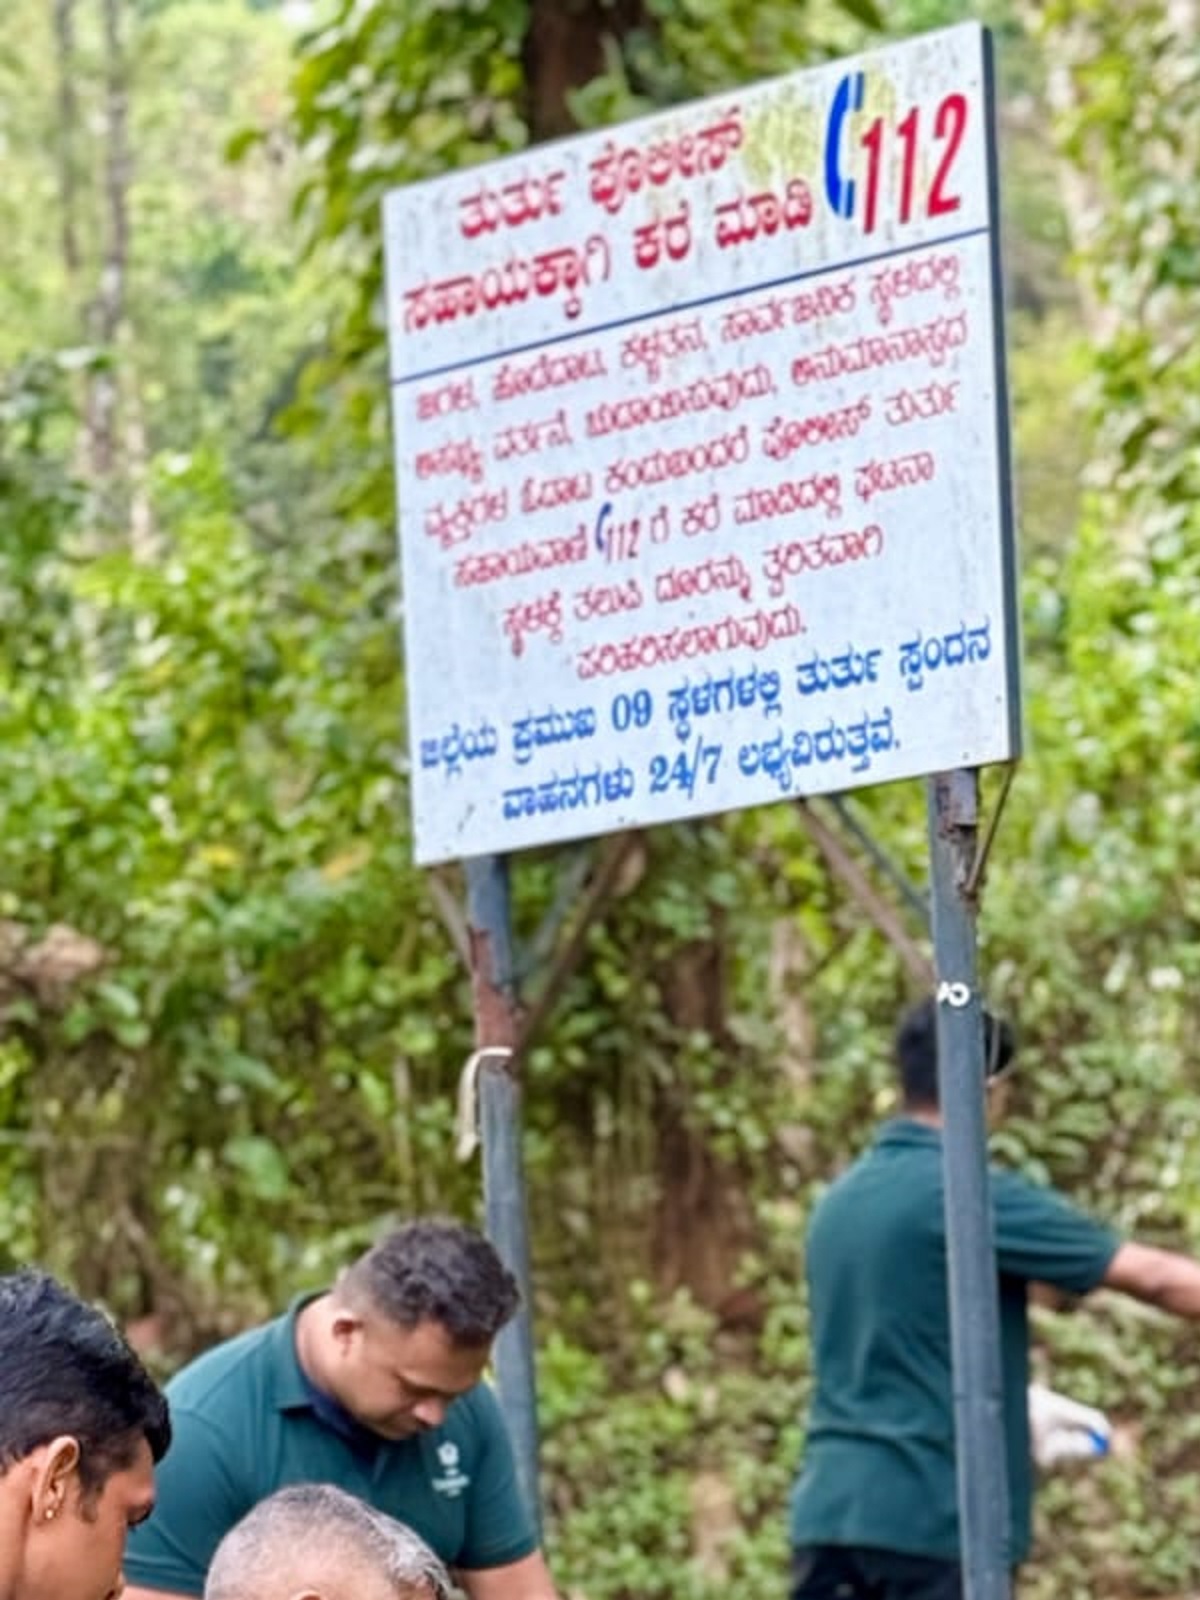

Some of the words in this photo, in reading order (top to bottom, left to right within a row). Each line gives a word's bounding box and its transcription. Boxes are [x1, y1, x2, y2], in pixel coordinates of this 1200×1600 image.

[403, 234, 611, 331] ಸಹಾಯಕ್ಕಾಗಿ
[633, 200, 692, 270] ಕರೆ
[714, 178, 813, 249] ಮಾಡಿ
[861, 92, 968, 236] 112
[459, 170, 565, 239] ತುರ್ತು
[885, 381, 960, 426] ತುರ್ತು
[605, 517, 641, 563] 112
[681, 494, 721, 537] ಕರೆ
[576, 603, 808, 681] ಪರಿಹರಿಸಲಾಗುವುದು.
[611, 689, 653, 732] 09
[667, 665, 783, 743] ಸ್ಥಳಗಳಲ್ಲಿ
[795, 645, 883, 697] ತುರ್ತು
[898, 618, 992, 693] ಸ್ಪಂದನ
[501, 761, 635, 821] ವಾಹನಗಳು
[648, 737, 723, 801] 24/7
[737, 706, 901, 792] ಲಭ್ಯವಿರುತ್ತವೆ.
